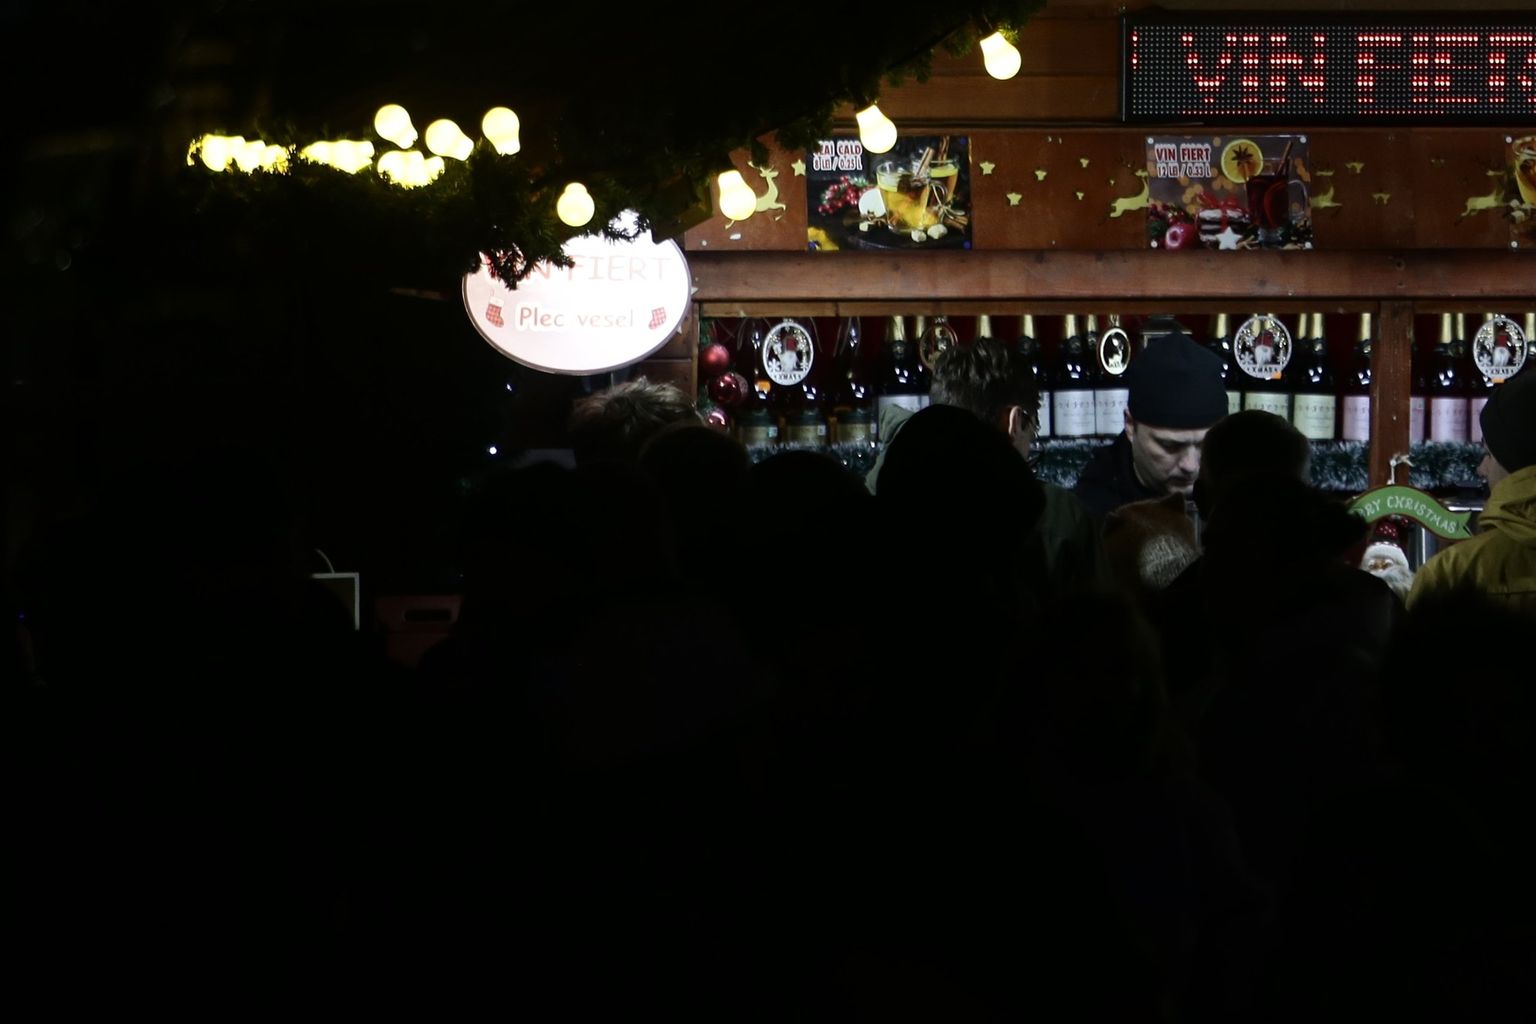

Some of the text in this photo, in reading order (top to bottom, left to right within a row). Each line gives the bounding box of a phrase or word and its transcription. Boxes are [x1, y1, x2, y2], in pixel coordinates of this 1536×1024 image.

[1182, 34, 1325, 104] VIN
[837, 142, 862, 155] CALD
[1156, 146, 1210, 161] VIN FIERT
[822, 158, 831, 169] LEI
[1158, 165, 1167, 176] 12
[1169, 165, 1179, 176] LEI
[567, 254, 672, 281] FIERT
[519, 306, 635, 328] Plec vesel
[1386, 495, 1457, 534] CHRISTMAS
